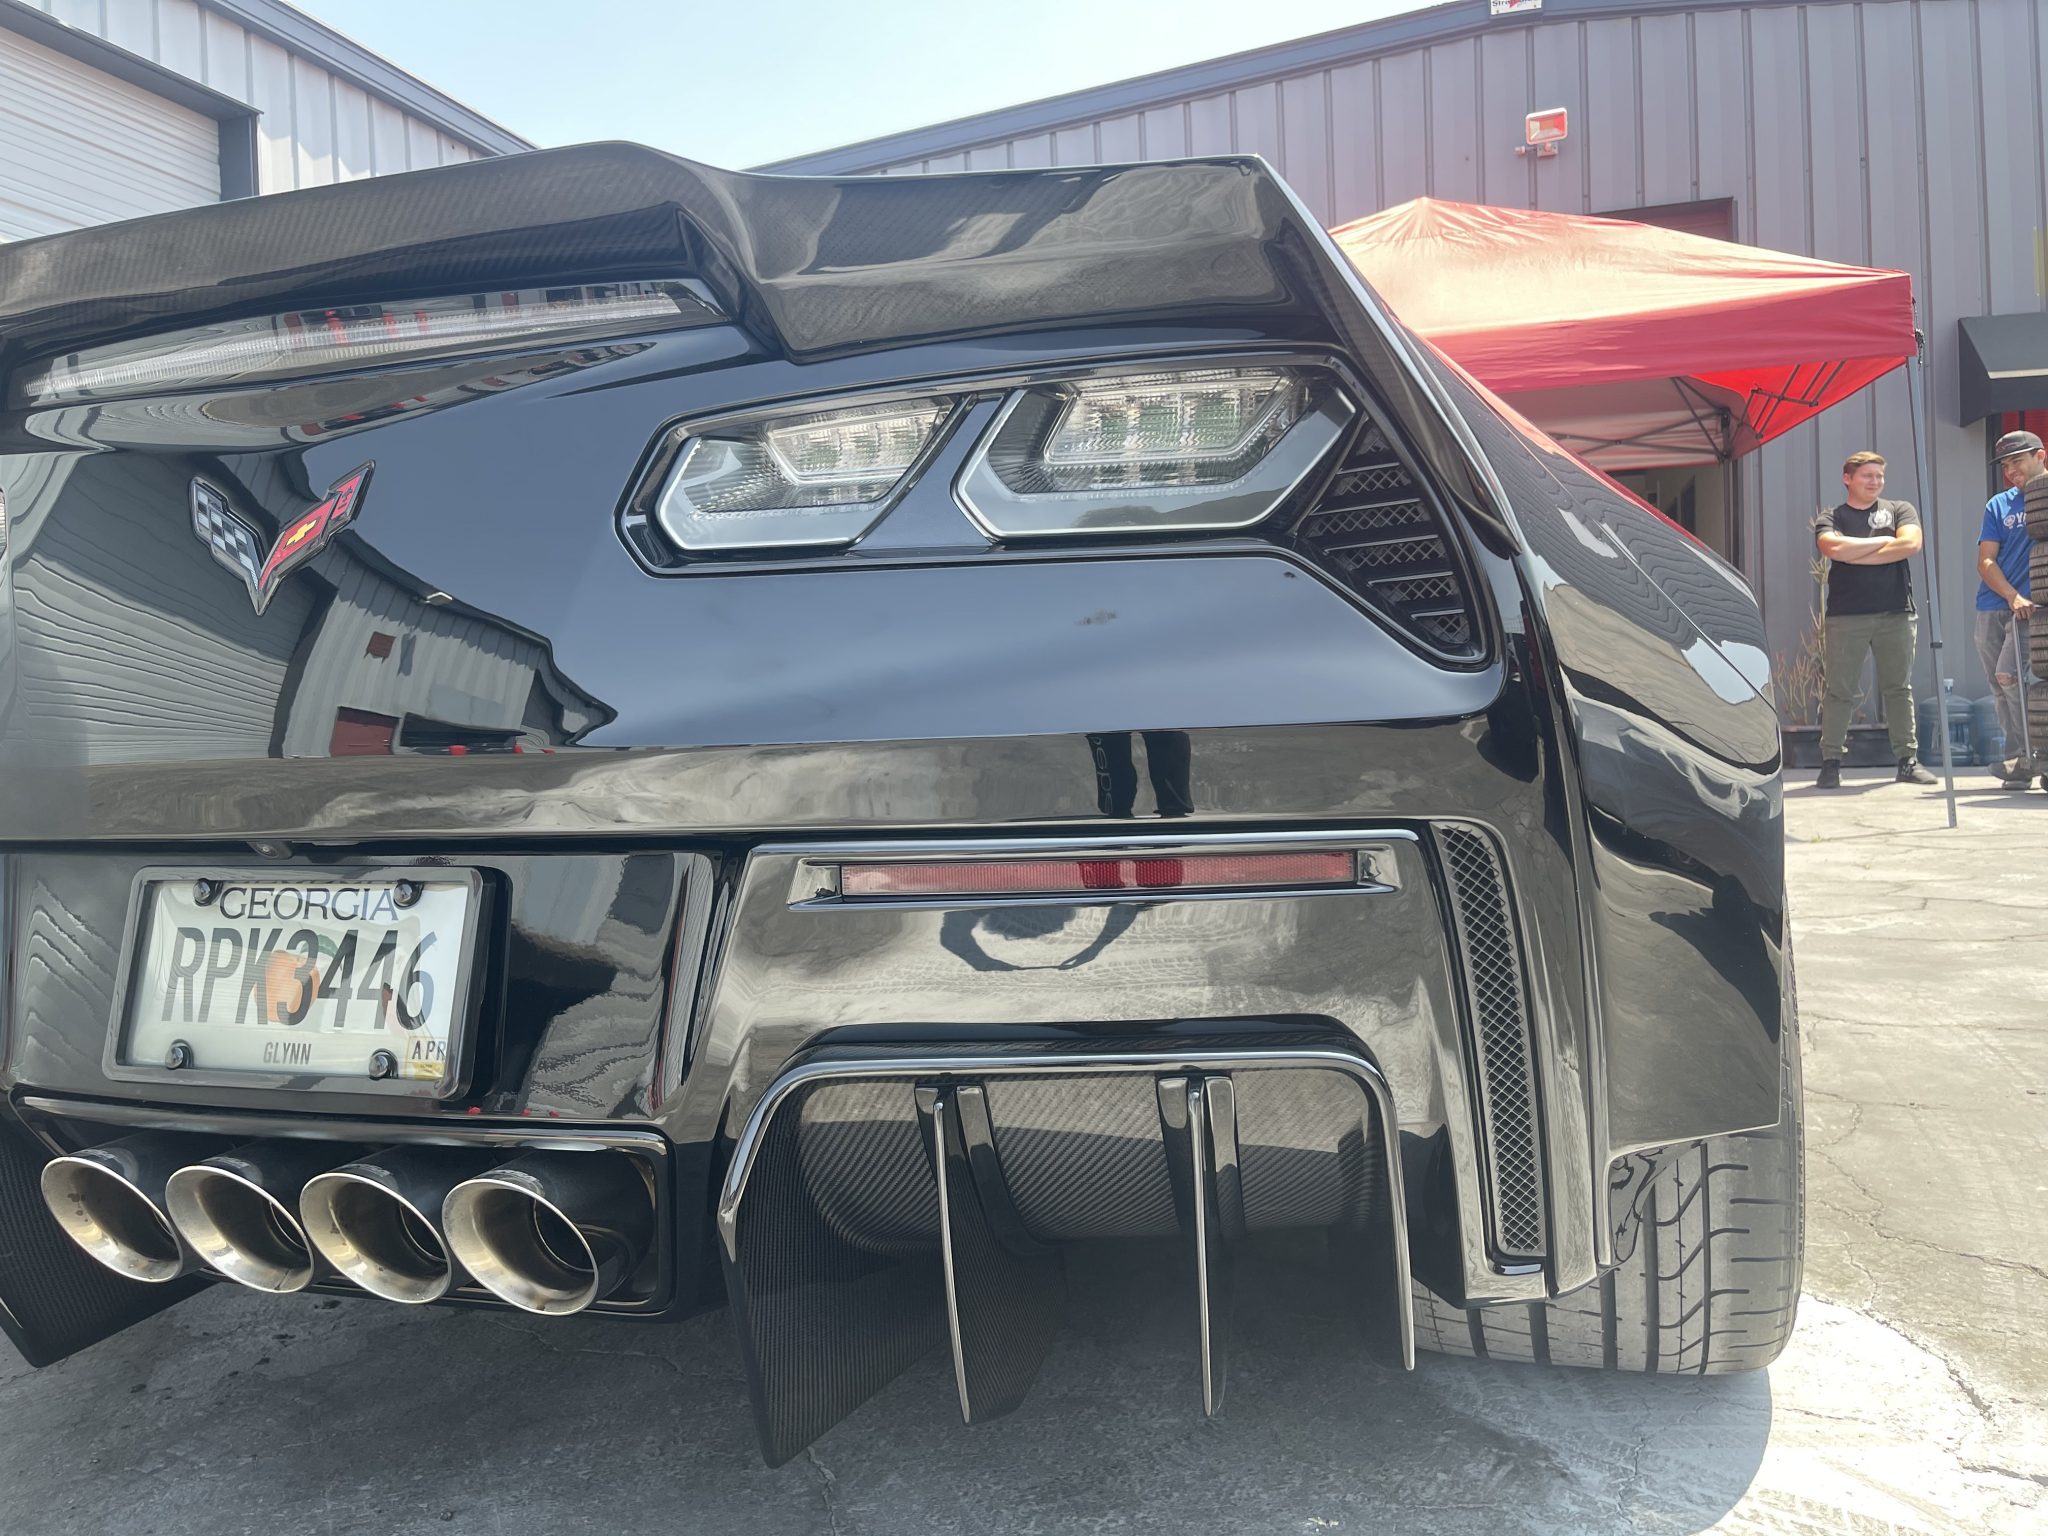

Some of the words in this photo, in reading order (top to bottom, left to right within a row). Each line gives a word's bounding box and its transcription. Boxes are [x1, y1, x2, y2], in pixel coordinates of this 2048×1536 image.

[219, 886, 399, 921] GEORGIA
[161, 926, 438, 1031] RPK3446
[263, 1041, 312, 1066] GLYNN
[412, 1039, 446, 1061] APR
